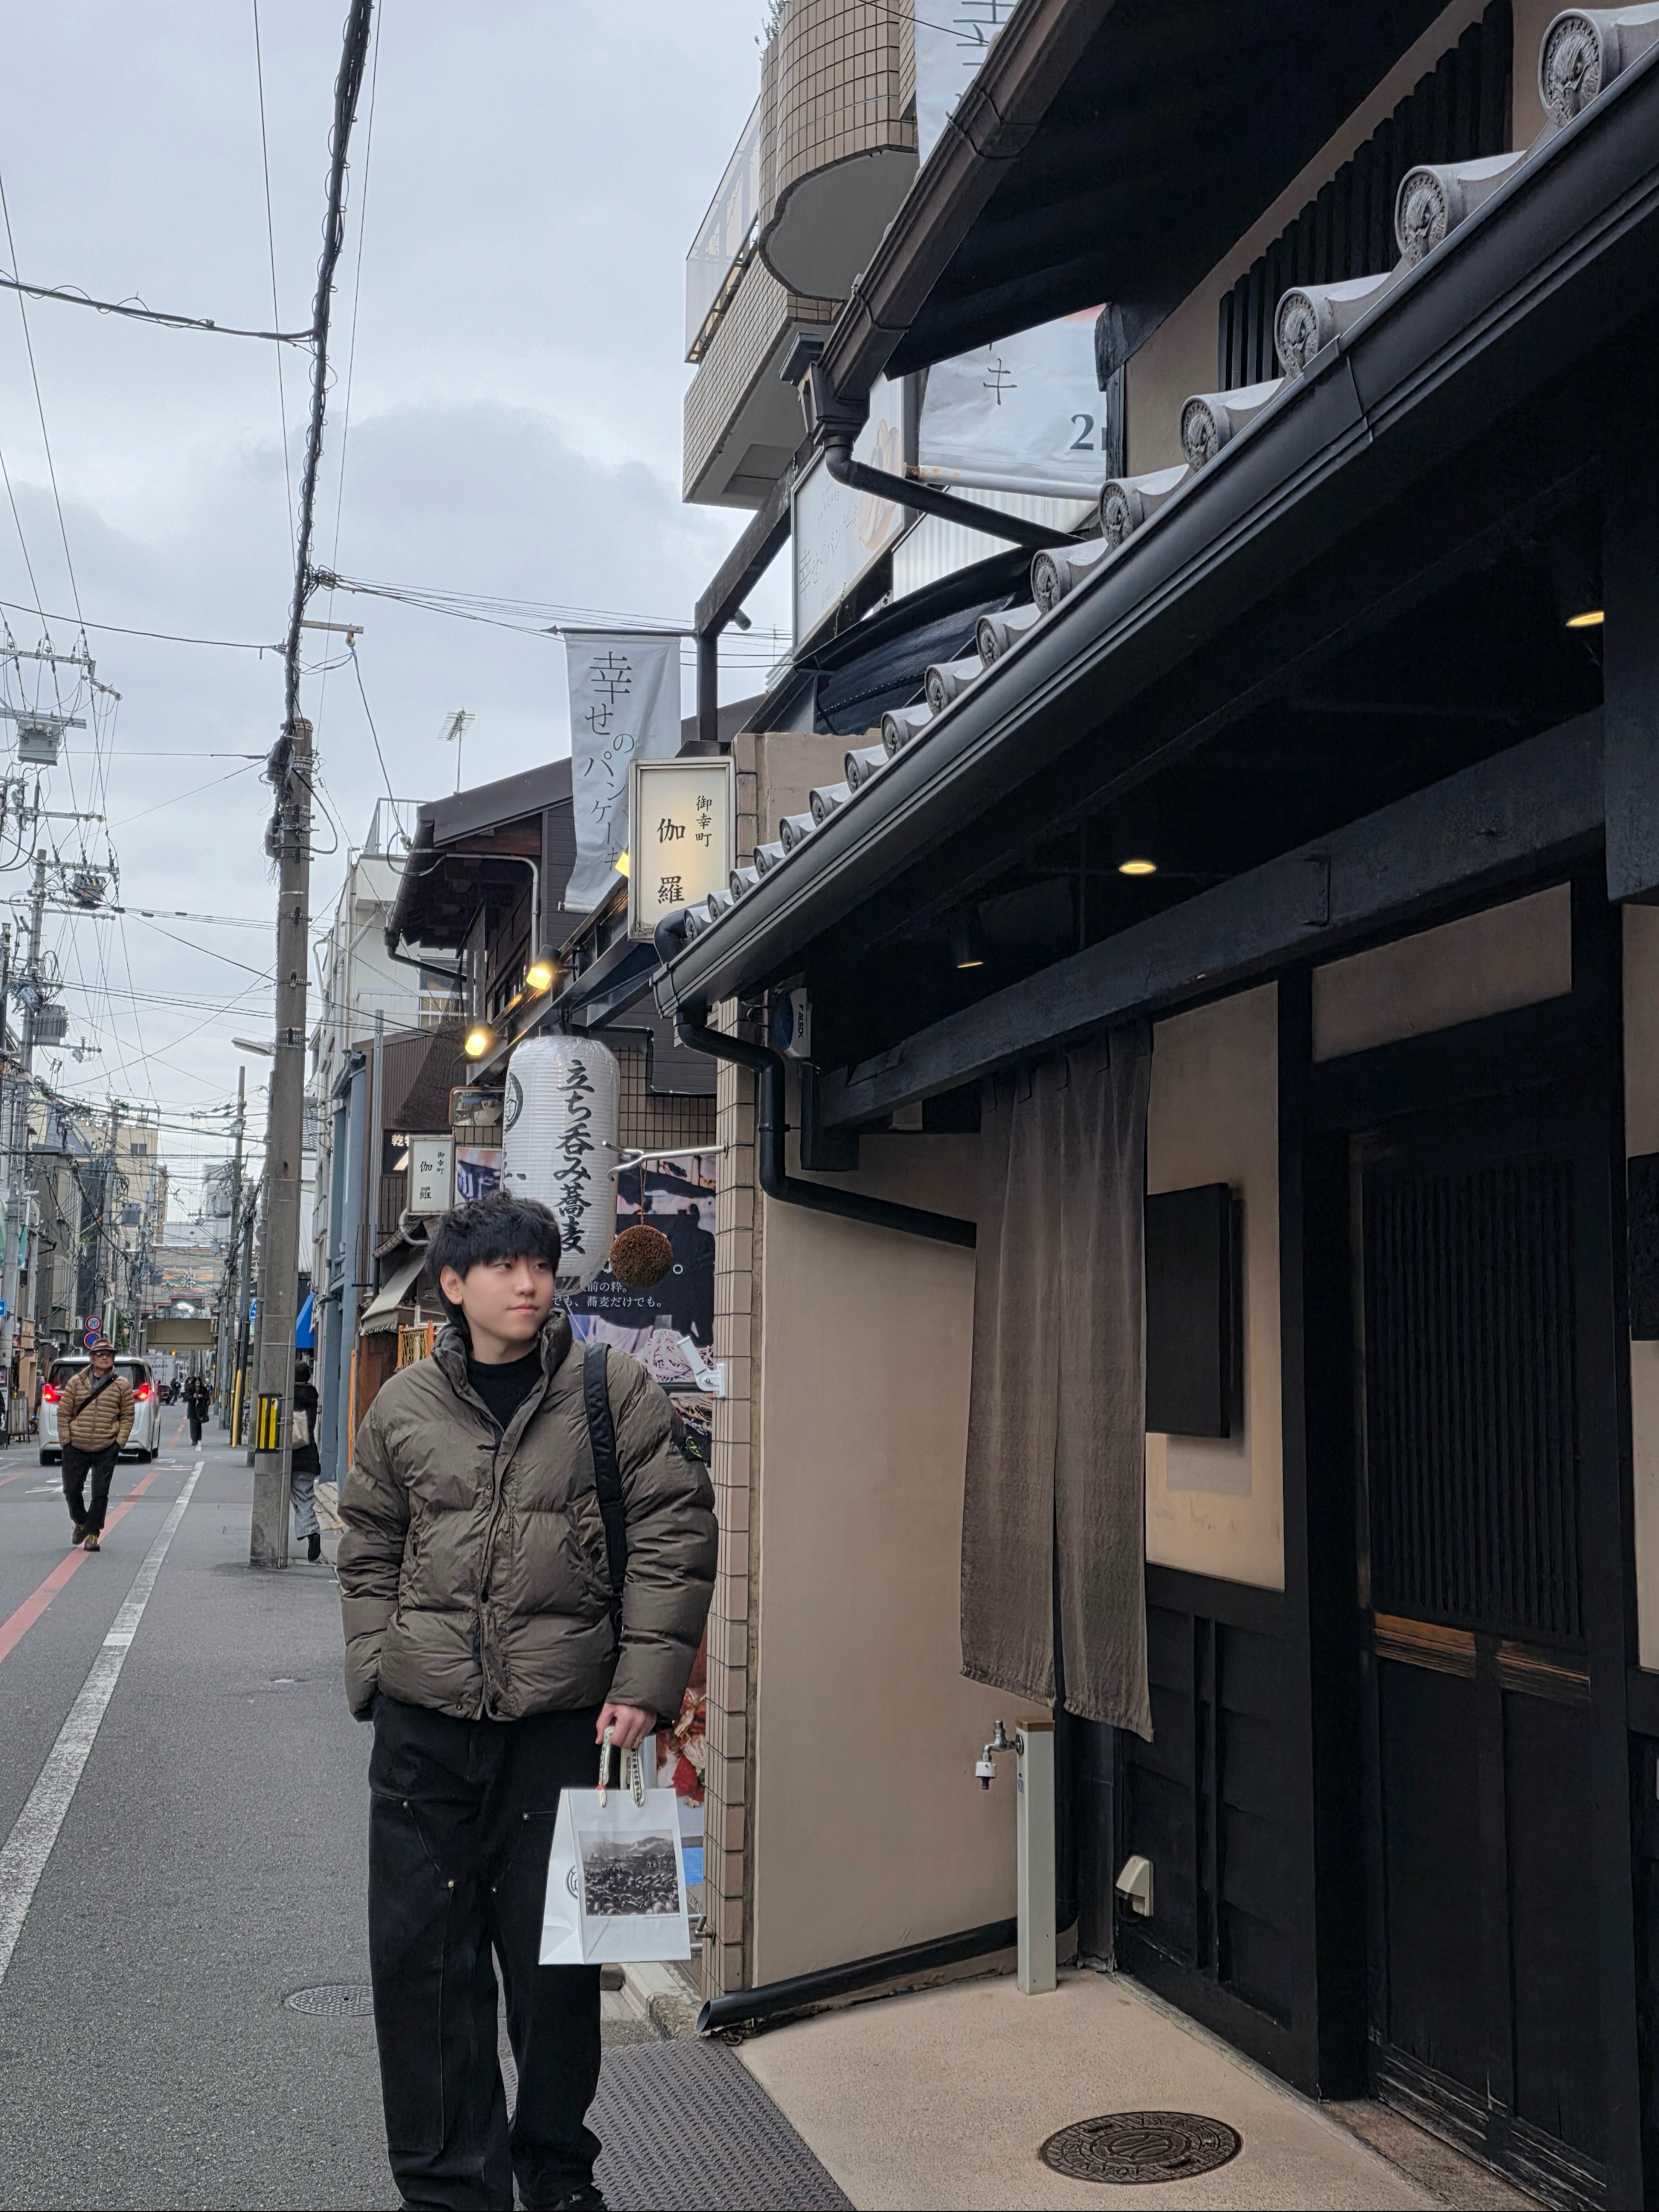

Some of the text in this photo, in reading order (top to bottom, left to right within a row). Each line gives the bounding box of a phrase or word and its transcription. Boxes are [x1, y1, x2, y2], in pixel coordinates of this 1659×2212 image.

[1070, 414, 1107, 451] 2
[583, 651, 635, 872] 幸せのパンケーキ
[695, 795, 712, 847] 御幸町
[656, 817, 686, 905] 伽羅
[436, 1151, 445, 1175] 御幸町
[553, 1058, 596, 1255] 立ち呑み蕎麦
[419, 1161, 433, 1200] 伽羅
[582, 1281, 627, 1293] 前の粋。
